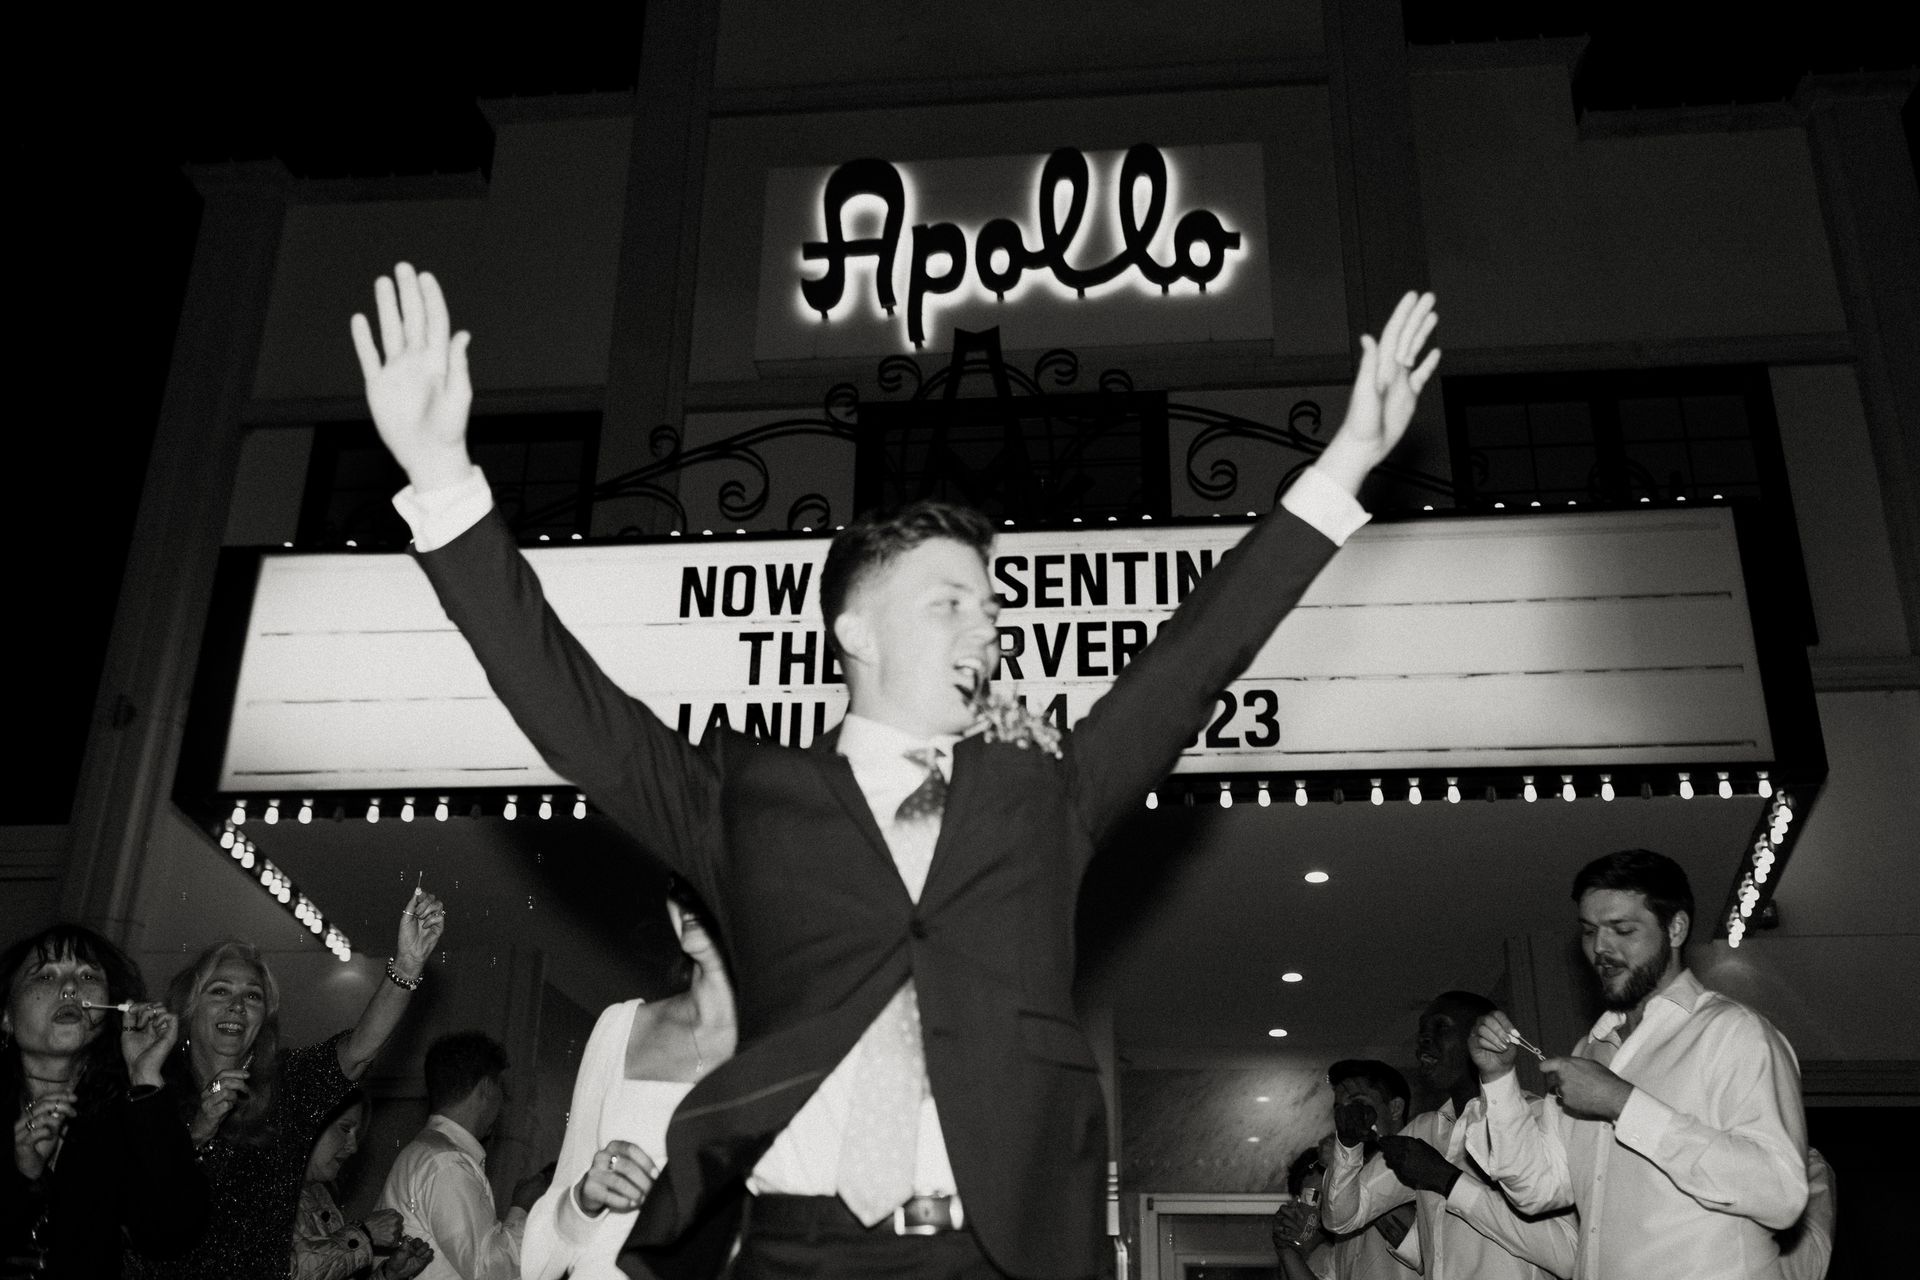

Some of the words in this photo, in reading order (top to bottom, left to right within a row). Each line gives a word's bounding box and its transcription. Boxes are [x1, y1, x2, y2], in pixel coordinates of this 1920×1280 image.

[801, 143, 1241, 345] Apollo
[680, 563, 813, 618] NOW
[994, 550, 1226, 609] SENTIN
[991, 621, 1166, 681] RVER
[1185, 690, 1279, 748] 23
